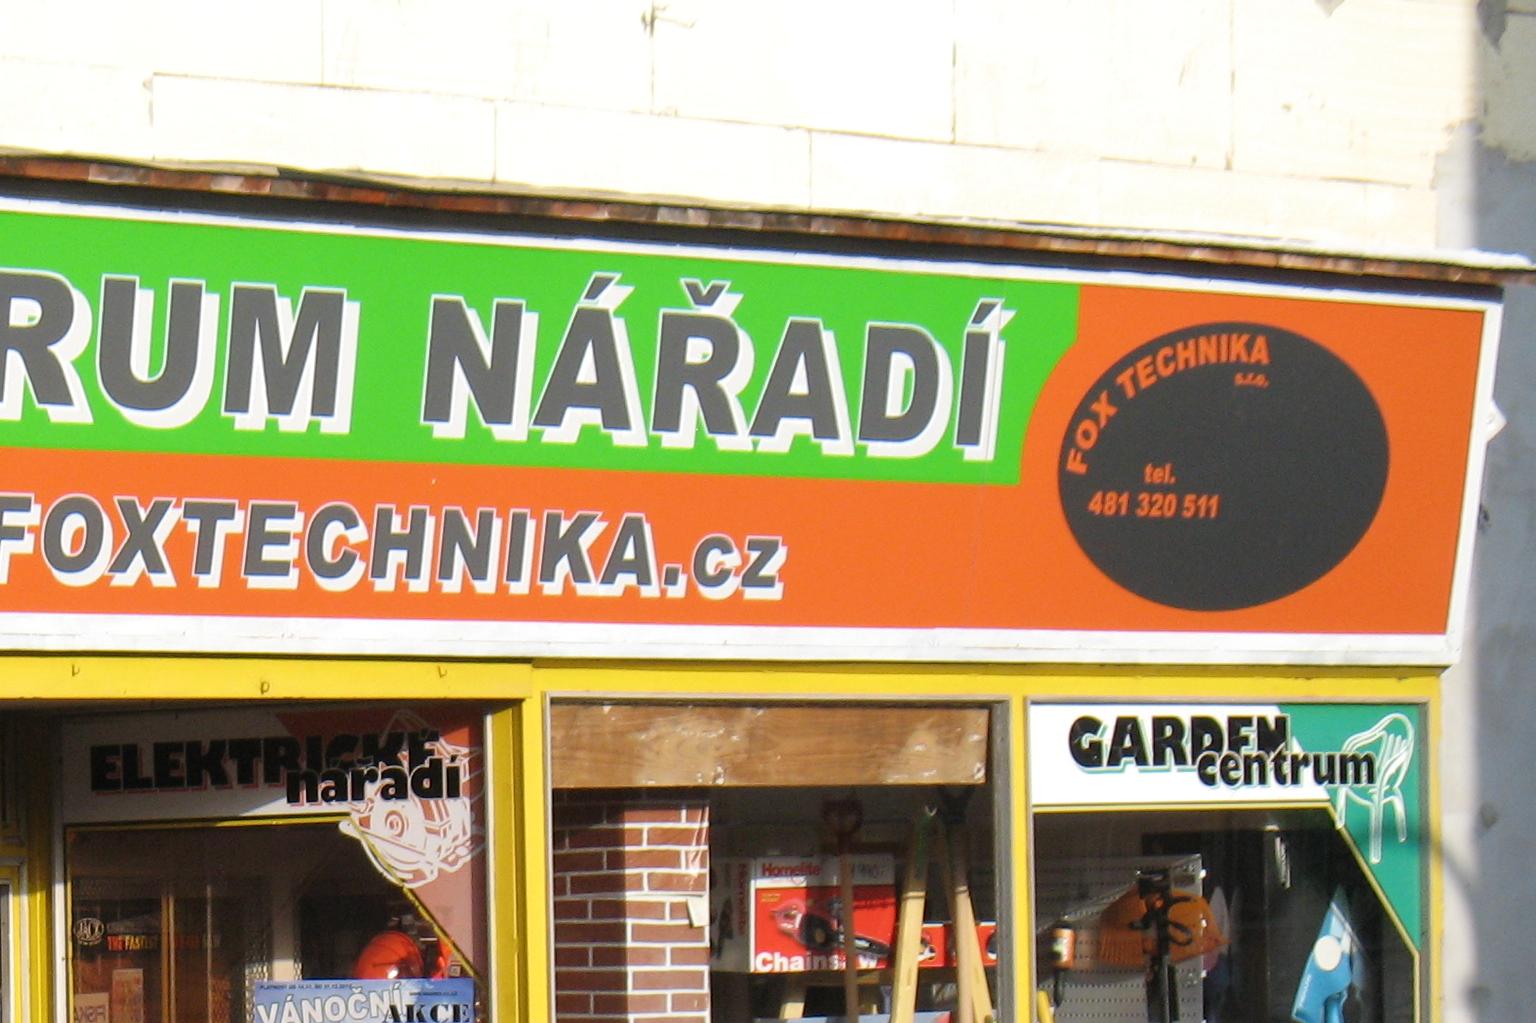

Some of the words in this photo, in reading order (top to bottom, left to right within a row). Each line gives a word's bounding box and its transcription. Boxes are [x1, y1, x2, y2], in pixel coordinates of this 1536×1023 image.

[420, 272, 1017, 462] NÁŘADÍ
[1233, 371, 1271, 389] s.r.o.
[1066, 392, 1119, 476] FOX
[1115, 333, 1271, 401] TECHNIKA
[1144, 462, 1177, 486] tel.
[1087, 491, 1130, 517] 481
[1135, 493, 1178, 519] 320
[1181, 494, 1221, 520] 511
[1068, 714, 1289, 774] GARDEN
[1195, 744, 1377, 788] centrum
[761, 863, 822, 877] Homelite
[755, 950, 878, 973] Chainsw
